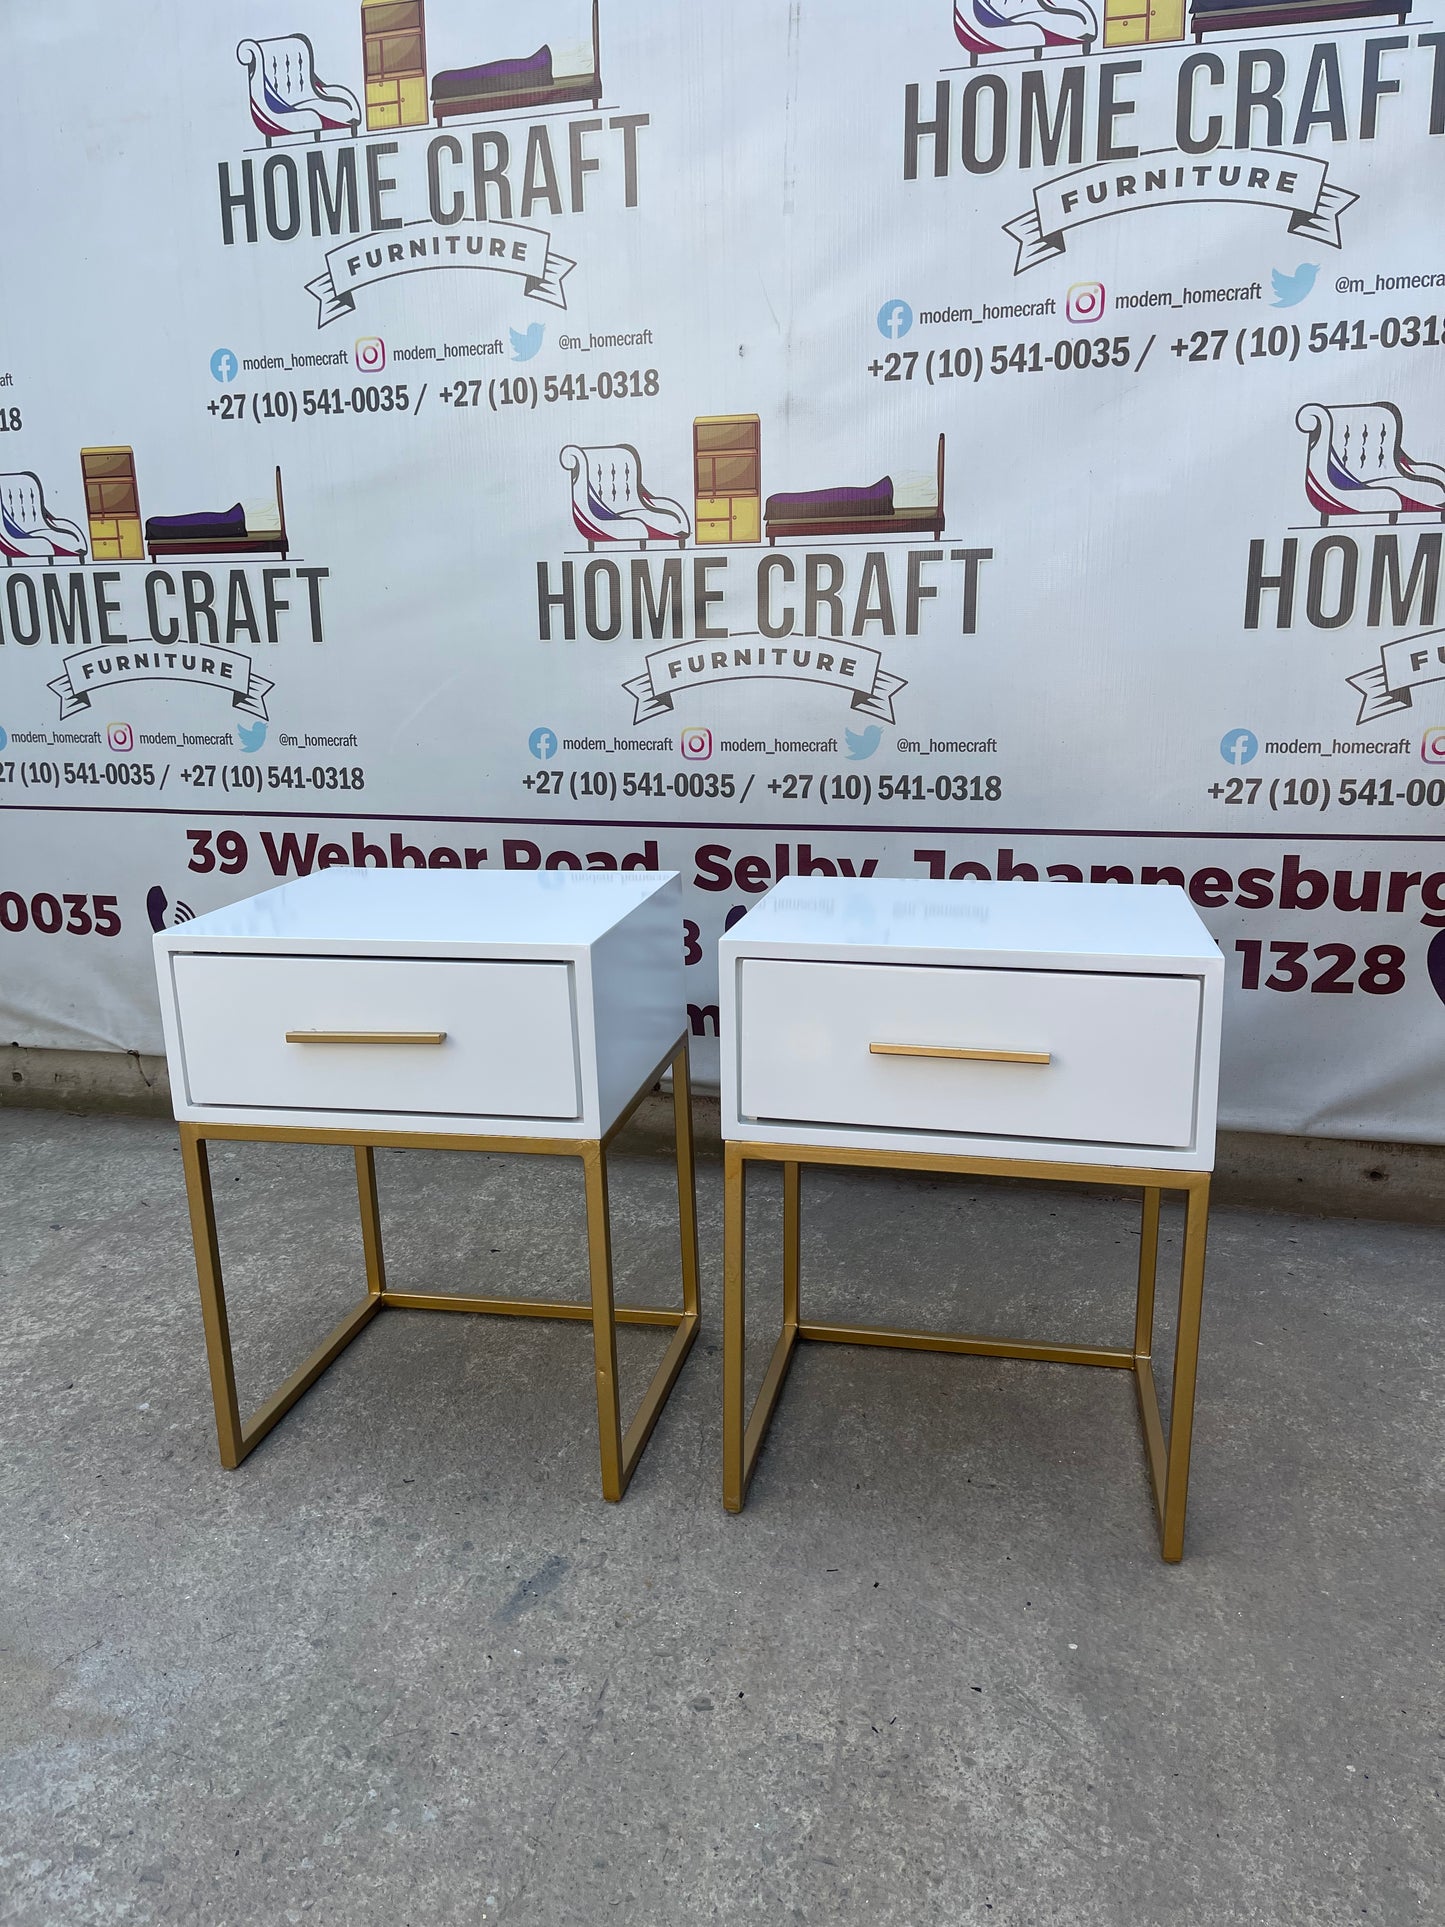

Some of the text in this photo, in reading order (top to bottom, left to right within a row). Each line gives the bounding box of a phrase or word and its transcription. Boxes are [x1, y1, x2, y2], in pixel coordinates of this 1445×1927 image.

[903, 59, 1143, 181] HOME
[218, 113, 650, 245] HOME CRAFT
[1062, 165, 1299, 214] FURNITURE
[347, 235, 529, 277] FURNITURE
[558, 329, 653, 353] @m_homecraft
[868, 315, 1445, 386] +27 (10) 541-0035 / +27 (10) 541-031
[208, 369, 660, 424] +27 (10) 541-0035 / +27 (10) 541-0318
[537, 548, 994, 641] HOME CRAFT
[1244, 533, 1445, 628] HOM
[145, 567, 330, 644] CRAFT
[82, 653, 233, 680] FURNITURE
[668, 649, 857, 678] FURNITURE
[279, 732, 358, 748] @m_homecraft
[897, 737, 997, 755] @m_homecraft
[21, 762, 60, 788] (10)
[64, 763, 155, 785] 541-0035
[160, 764, 170, 790] /
[180, 766, 216, 787] +27
[222, 766, 262, 791] (10)
[267, 767, 364, 789] 541-0318
[523, 770, 1002, 804] +27 (10) 541-0035 / +27 (10) 541-0318
[1208, 778, 1445, 812] +27 (10) 541-00
[186, 829, 248, 874] 39
[260, 831, 488, 877] Webber
[0, 891, 121, 936] 0035
[1235, 940, 1406, 994] 1328
